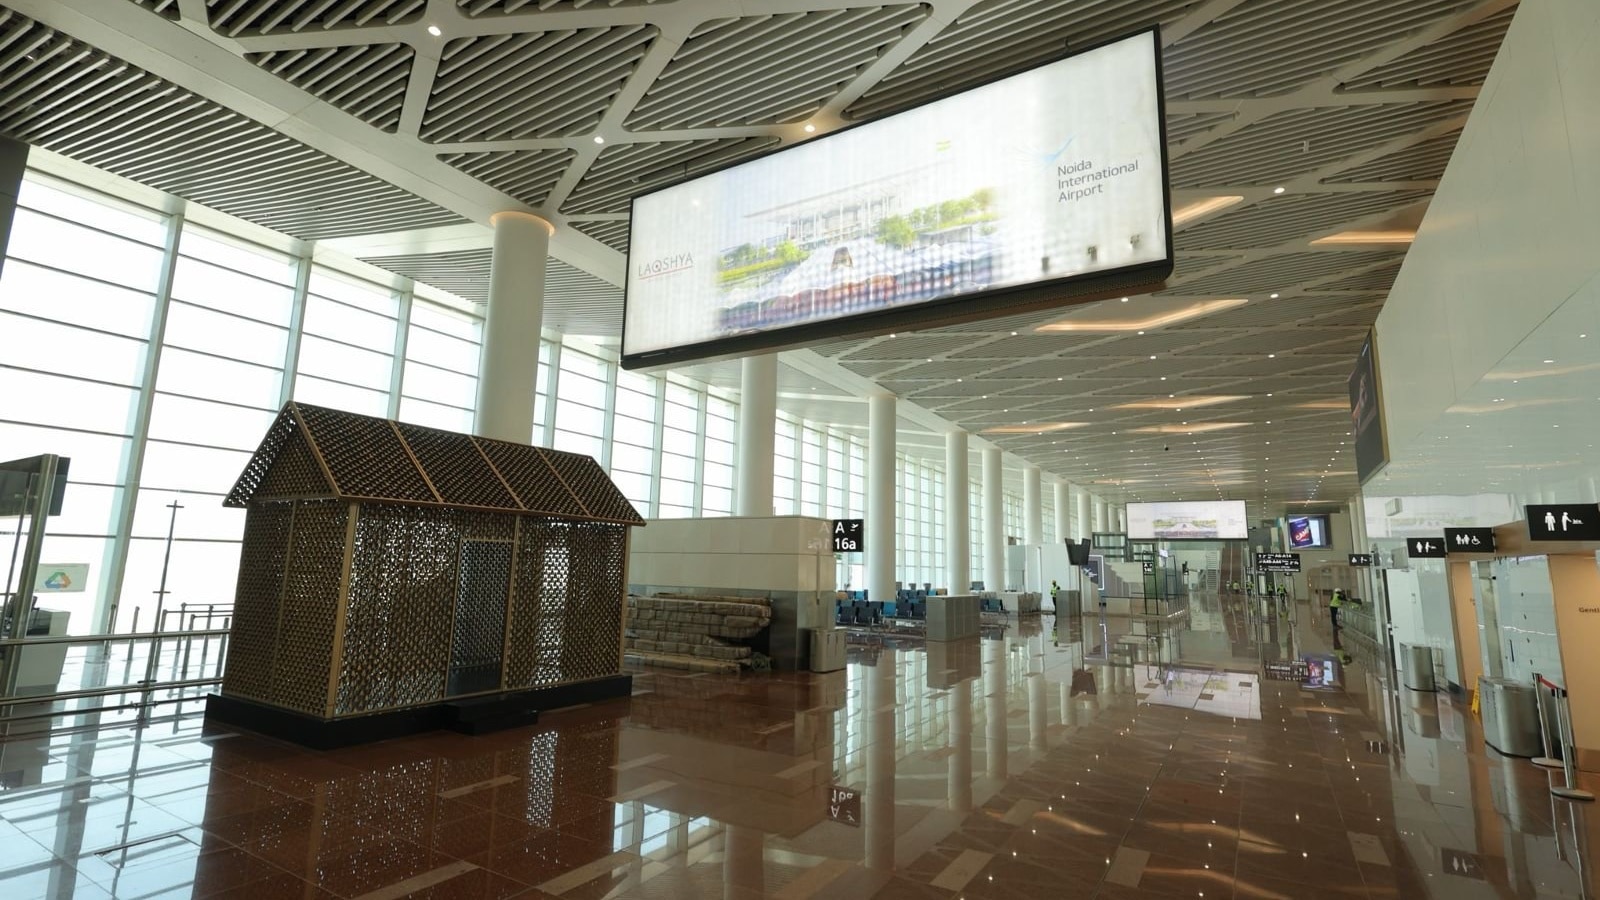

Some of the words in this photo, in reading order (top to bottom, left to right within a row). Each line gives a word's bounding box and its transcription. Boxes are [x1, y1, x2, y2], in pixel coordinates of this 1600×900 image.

[1057, 160, 1092, 176] Noida
[1058, 160, 1138, 189] International
[1058, 183, 1103, 202] Airport
[638, 252, 694, 277] LAQSHYA
[835, 522, 845, 533] A
[835, 538, 857, 550] 16a
